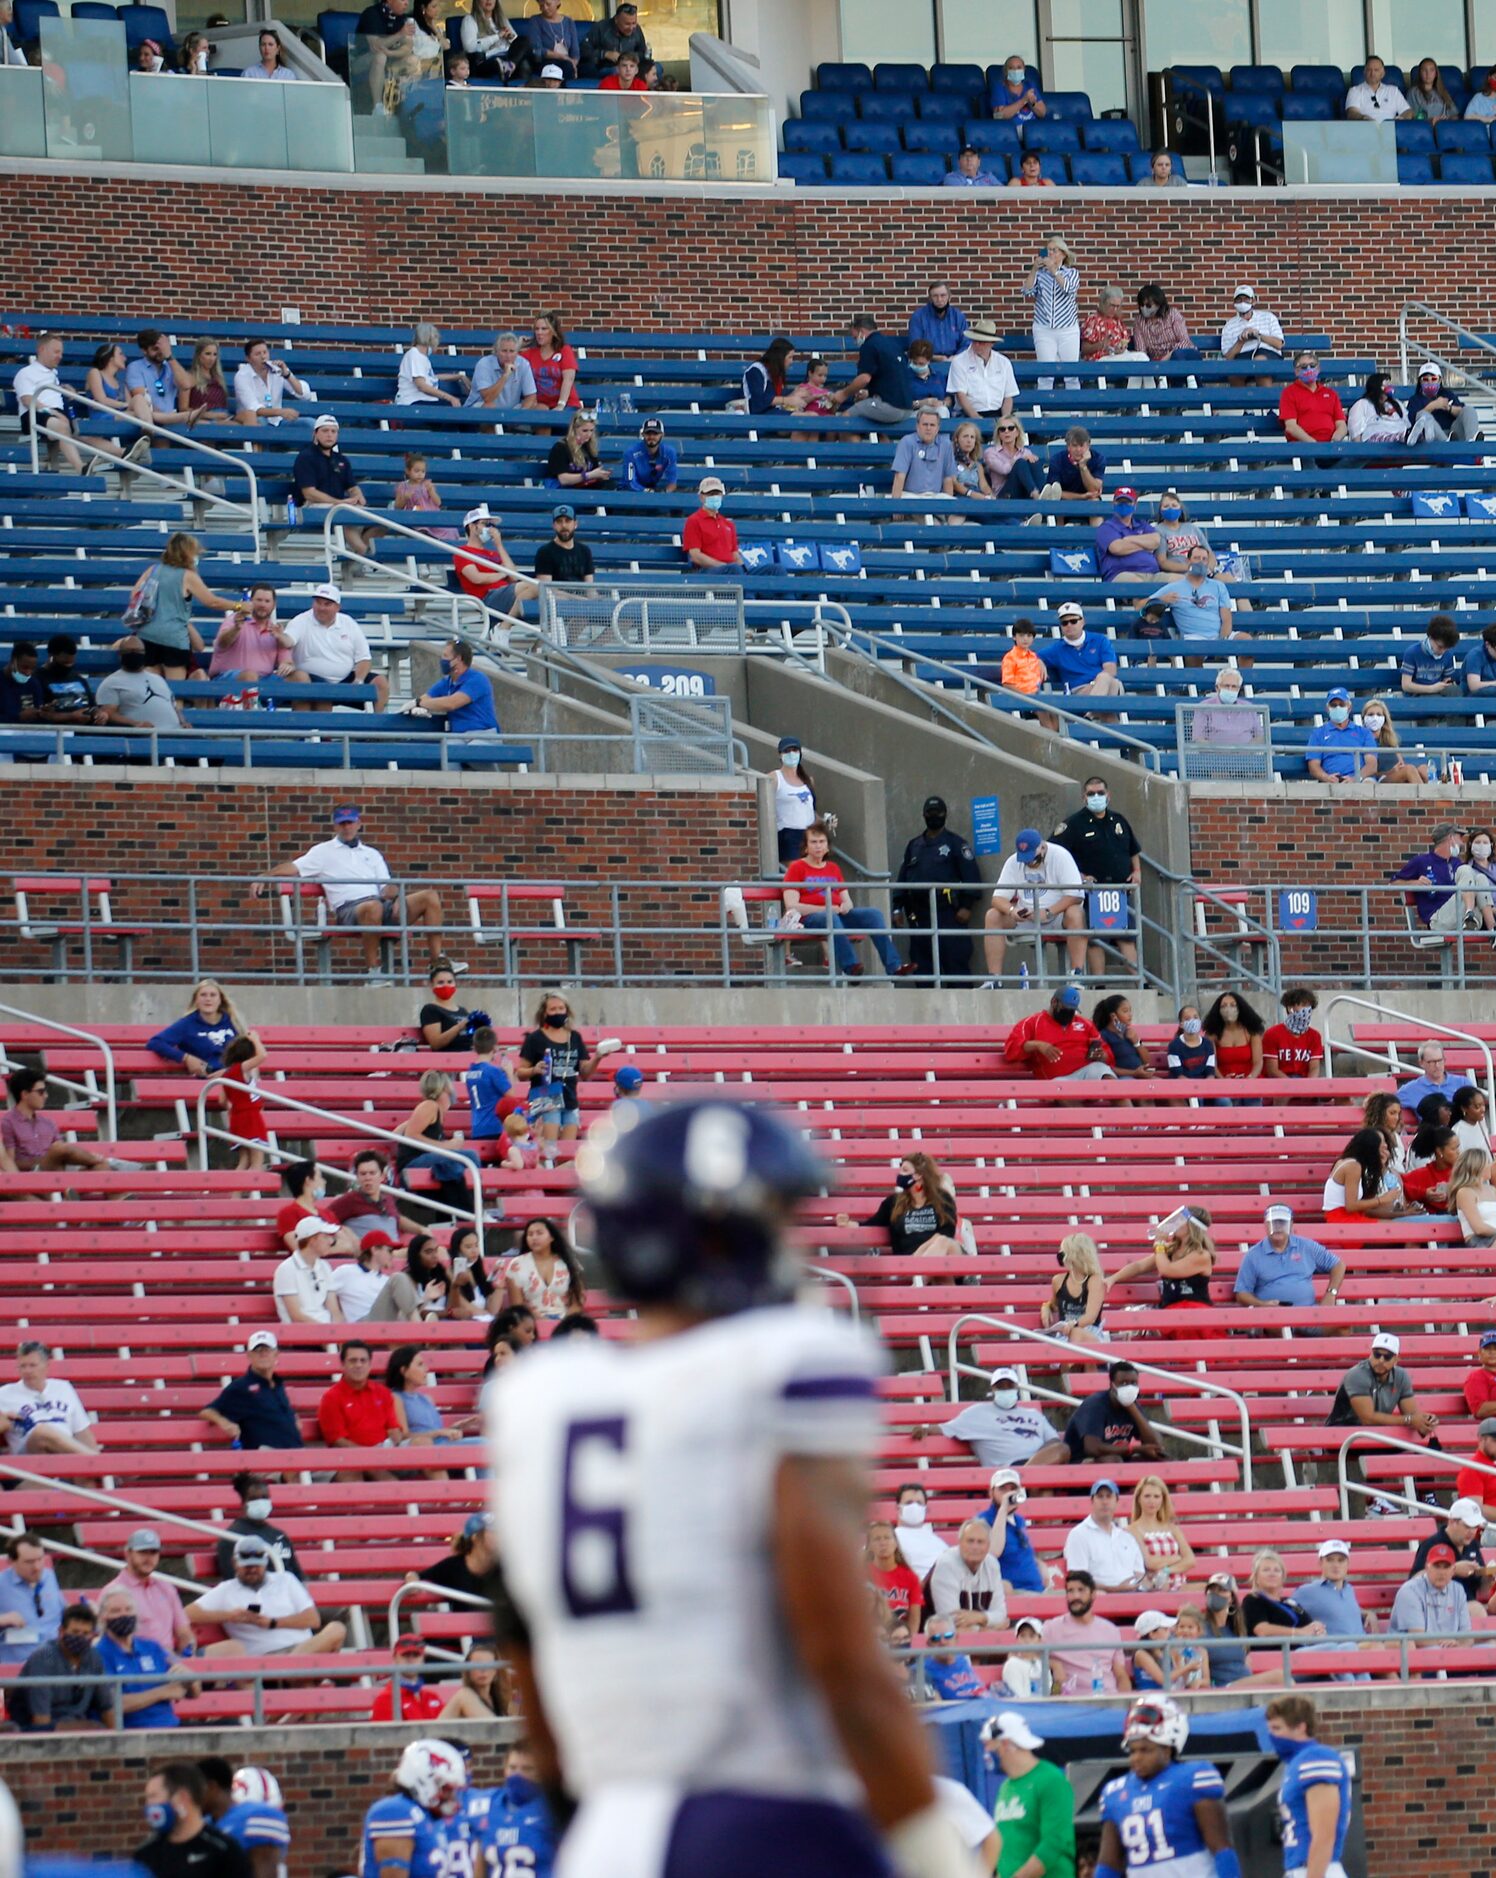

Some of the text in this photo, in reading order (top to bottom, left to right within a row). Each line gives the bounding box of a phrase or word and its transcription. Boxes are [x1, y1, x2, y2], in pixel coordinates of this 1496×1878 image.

[1167, 535, 1200, 551] SMU
[1097, 891, 1120, 912] 108
[1288, 893, 1310, 914] 109
[472, 1085, 481, 1109] 1
[563, 1416, 635, 1619] 6
[1121, 1808, 1174, 1865] 91
